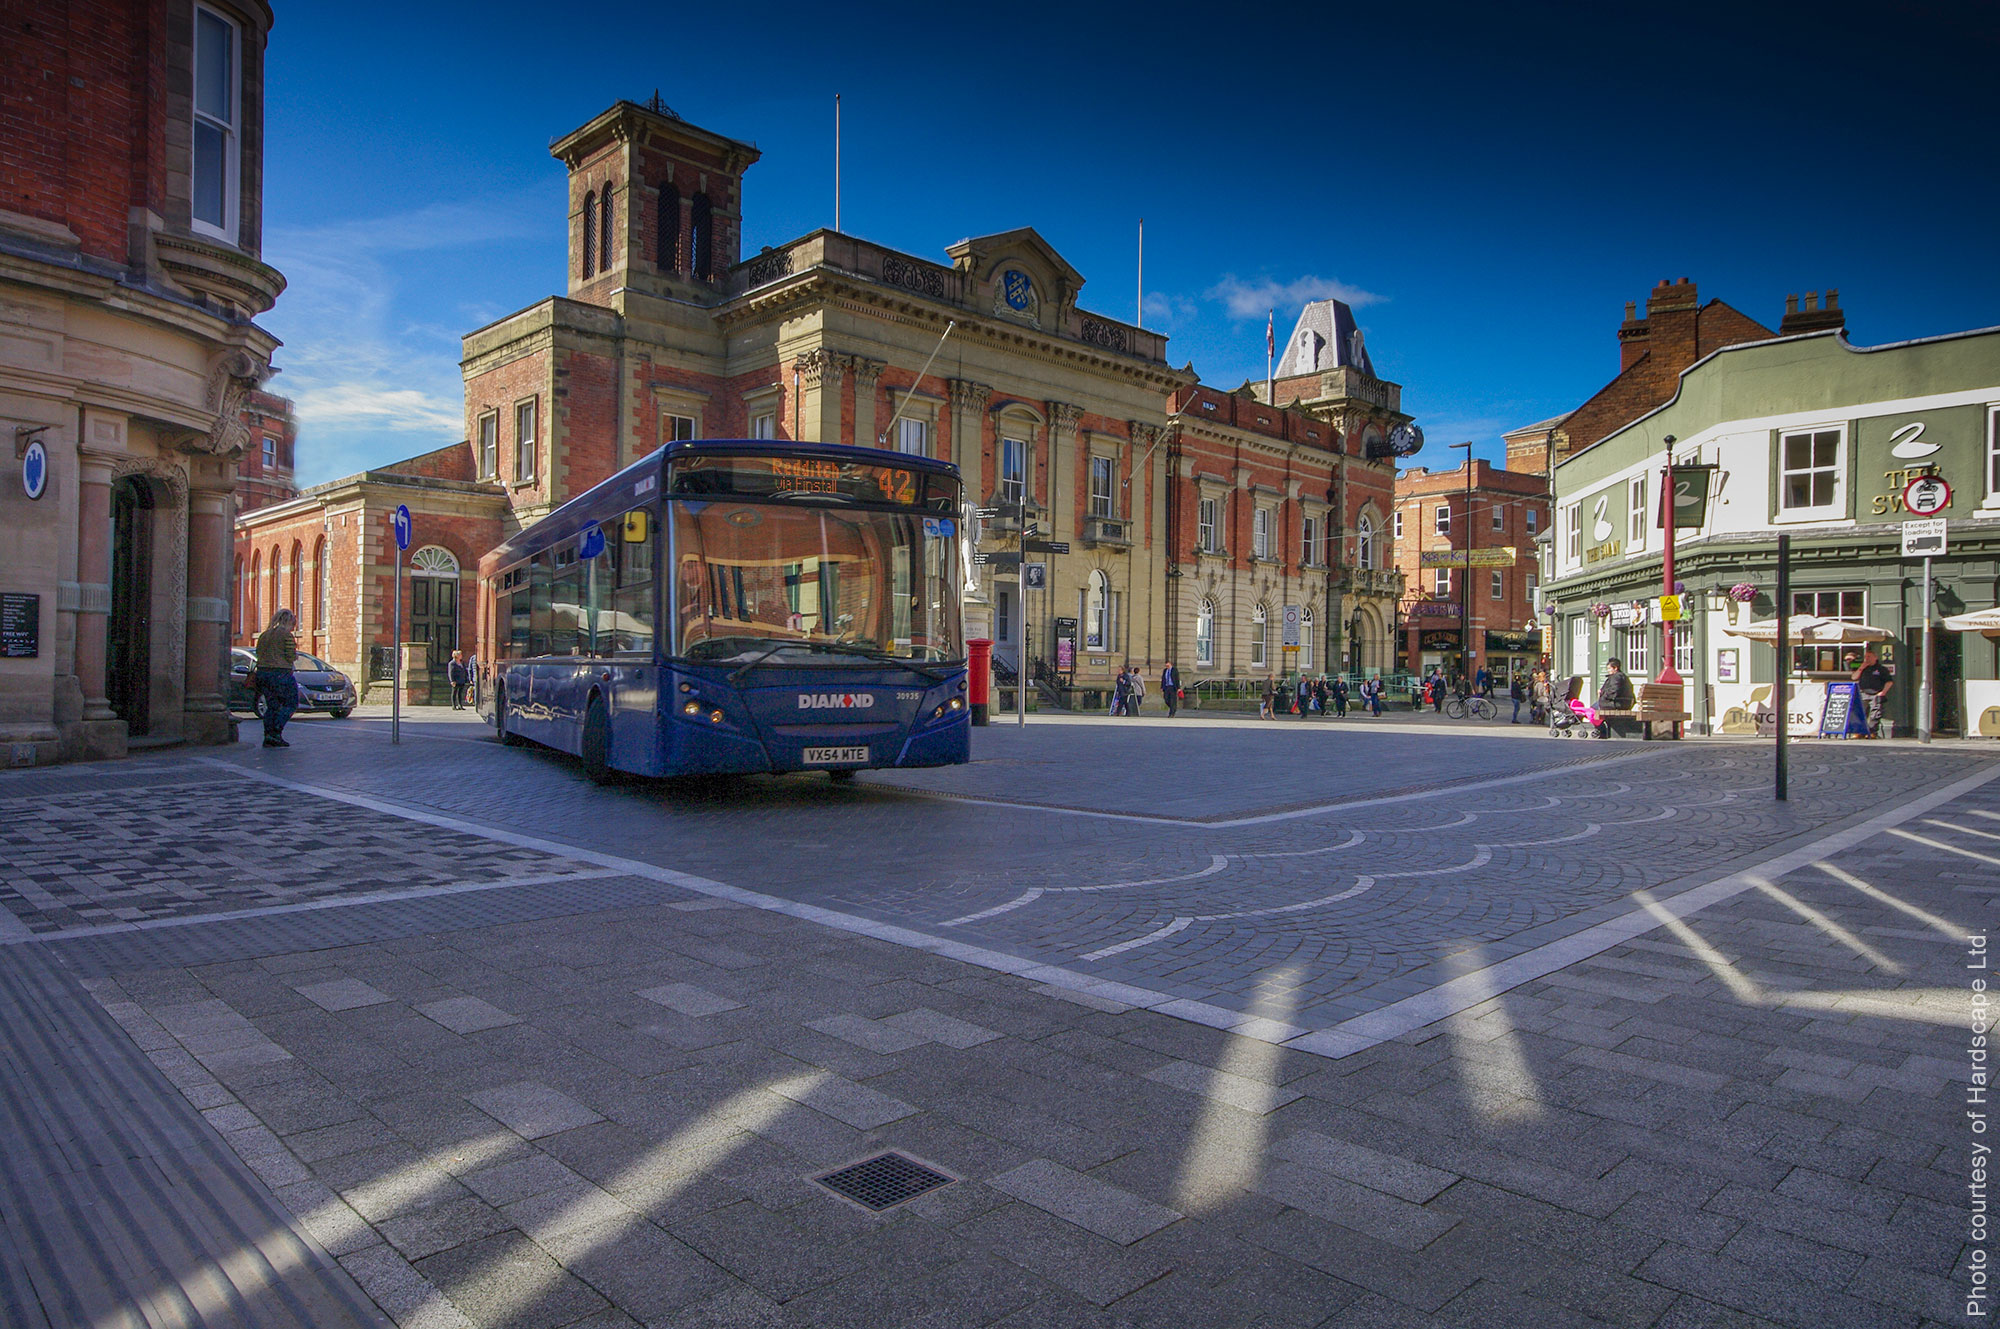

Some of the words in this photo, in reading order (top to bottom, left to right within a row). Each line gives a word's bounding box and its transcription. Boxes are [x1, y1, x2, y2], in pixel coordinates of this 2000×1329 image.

[772, 457, 841, 479] Redditch
[775, 475, 792, 492] via
[795, 477, 838, 494] Finstall
[878, 467, 912, 501] 42
[1905, 521, 1931, 530] Except
[1905, 528, 1932, 537] loading
[1934, 527, 1944, 536] by
[1586, 544, 1600, 564] THE
[1600, 539, 1620, 561] SWAN
[896, 691, 920, 700] 30935
[1729, 710, 1814, 724] THATCERS
[808, 748, 838, 762] VX54
[842, 747, 864, 761] MTE
